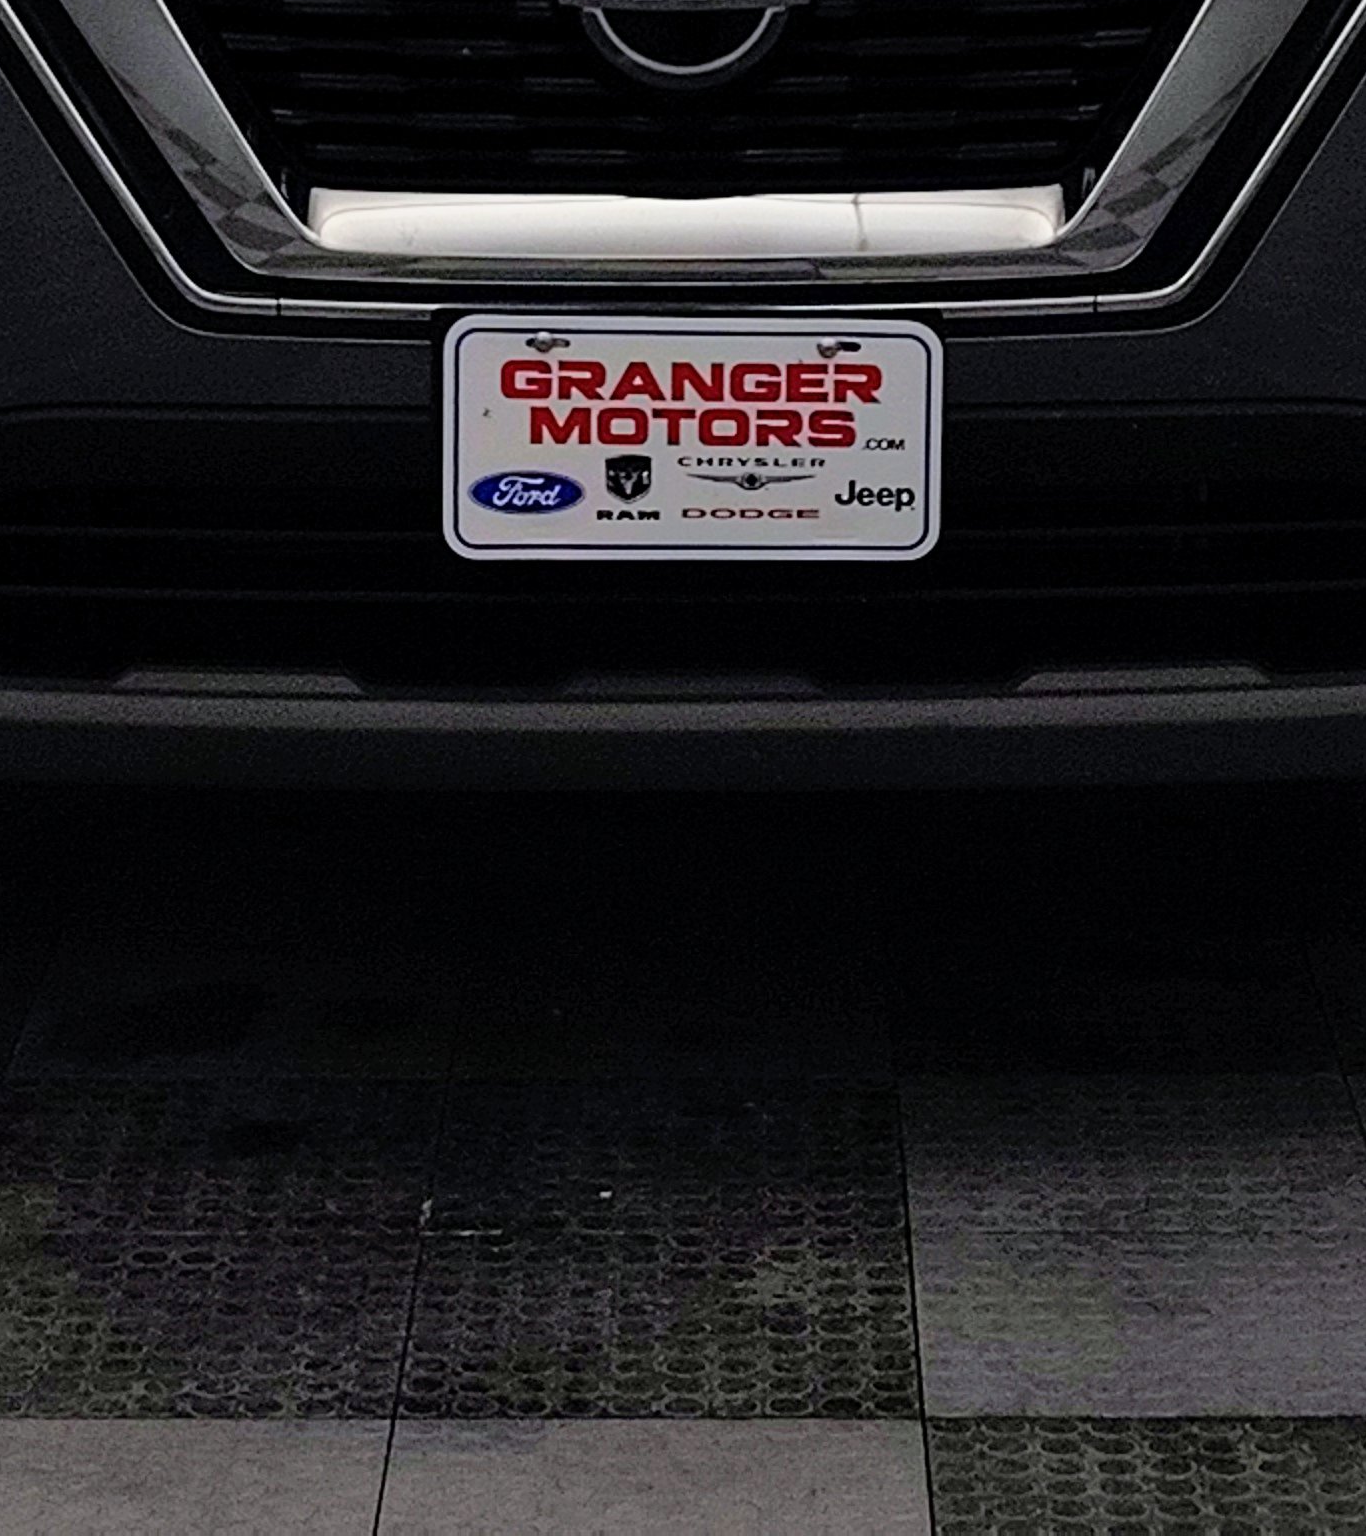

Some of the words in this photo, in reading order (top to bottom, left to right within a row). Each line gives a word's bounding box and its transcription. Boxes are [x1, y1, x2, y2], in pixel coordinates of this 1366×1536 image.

[500, 358, 883, 404] GRANGER
[529, 406, 856, 449] MOTORS
[677, 456, 826, 468] CHRYSLER
[491, 476, 562, 508] Ford
[834, 480, 916, 511] Jeep
[596, 508, 661, 521] RAM
[681, 507, 820, 520] DODGE
